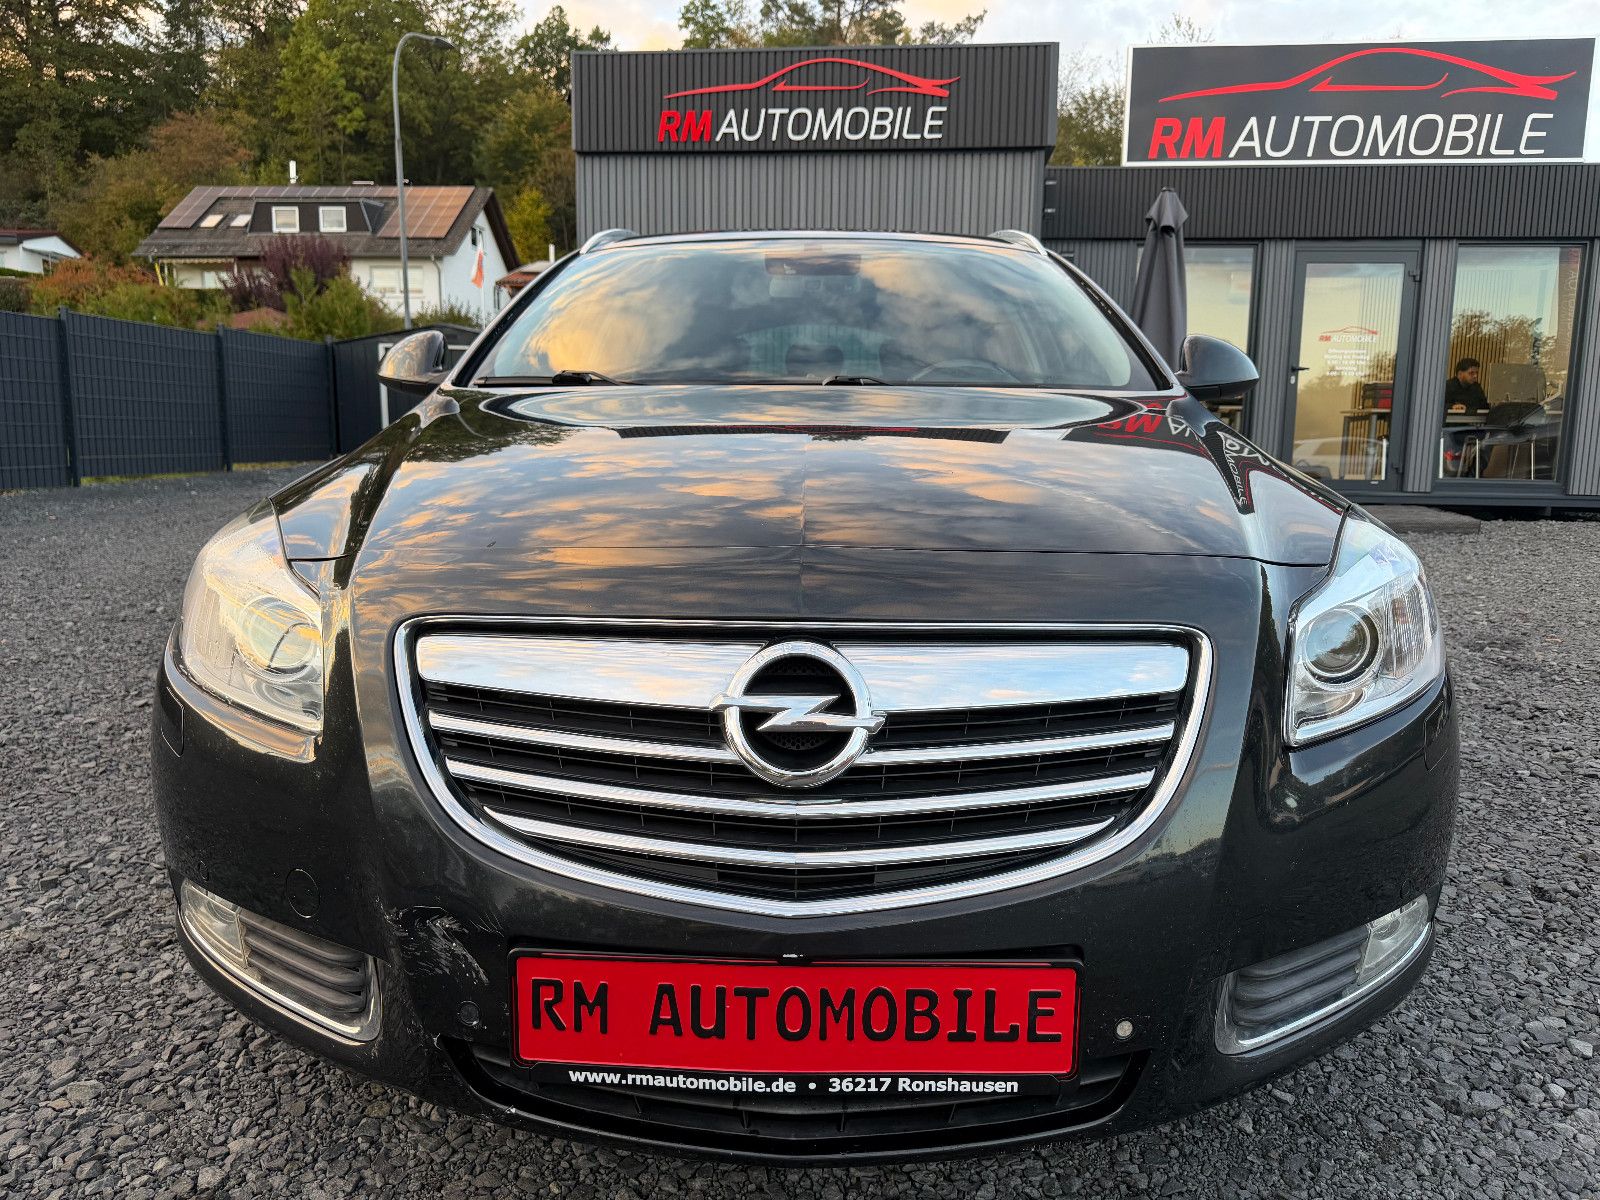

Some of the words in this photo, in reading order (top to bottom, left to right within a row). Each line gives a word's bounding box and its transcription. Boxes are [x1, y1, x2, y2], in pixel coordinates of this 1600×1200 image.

[657, 109, 712, 143] RM
[715, 106, 948, 142] AUTOMOBILE
[1147, 116, 1226, 160] RM
[1228, 112, 1554, 159] AUTOMOBILE
[531, 977, 609, 1034] RM
[649, 982, 1062, 1042] AUTOMOBILE
[568, 1069, 797, 1093] www.rmautomobile.de
[828, 1078, 892, 1093] 36217
[897, 1077, 1019, 1093] Ronshausen
